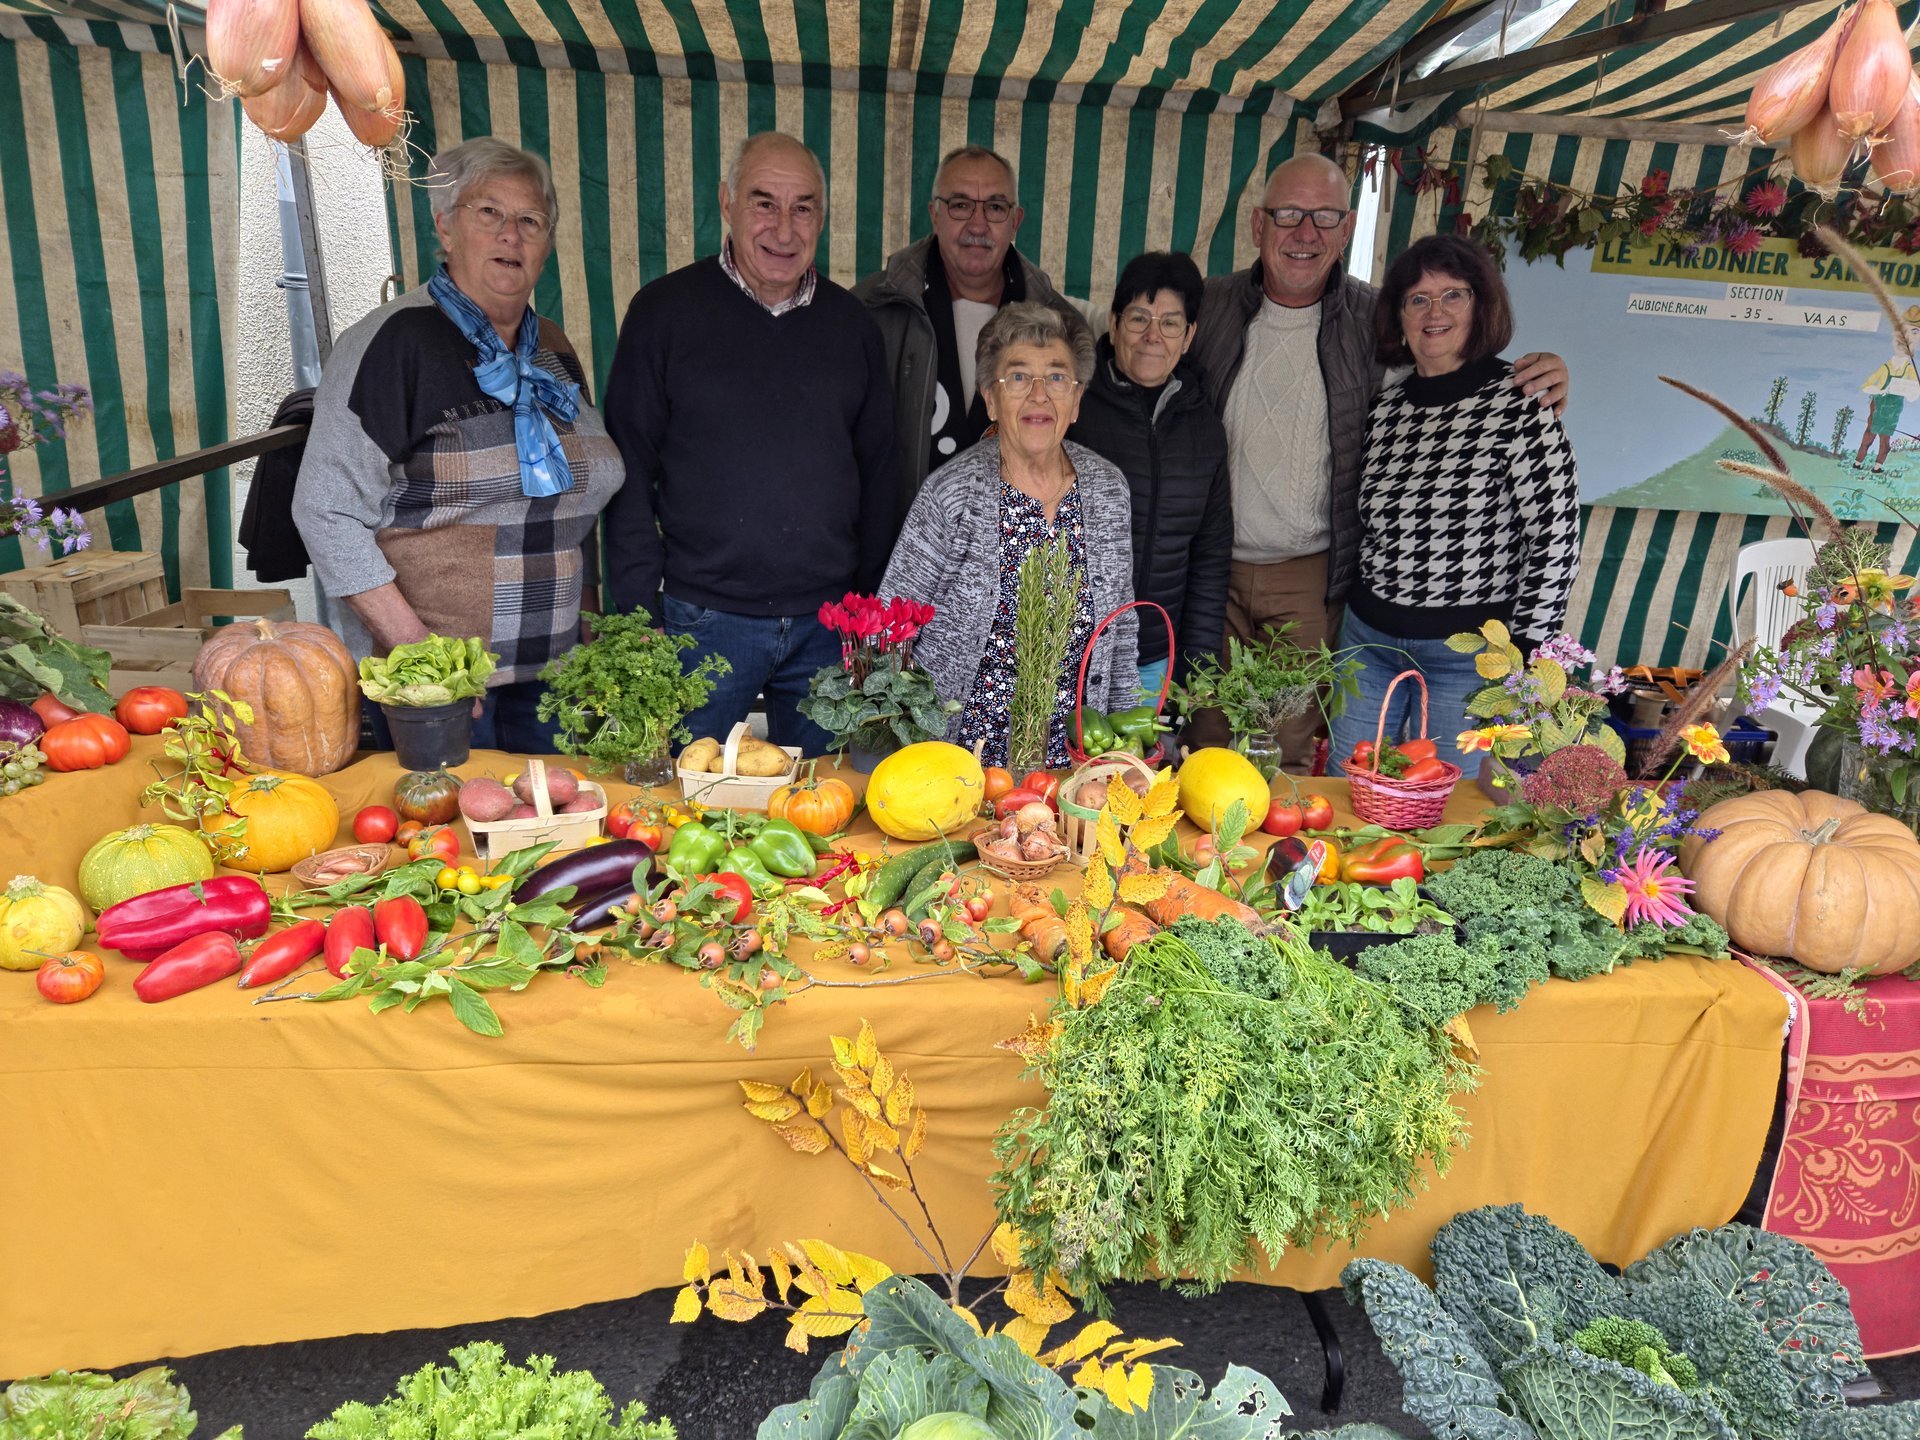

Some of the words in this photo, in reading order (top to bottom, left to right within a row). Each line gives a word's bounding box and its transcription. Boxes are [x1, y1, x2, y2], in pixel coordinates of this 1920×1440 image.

[1602, 240, 1632, 264] LE
[1649, 243, 1789, 276] JARDINIER
[1730, 286, 1783, 301] SECTION
[1804, 312, 1847, 326] VAAS
